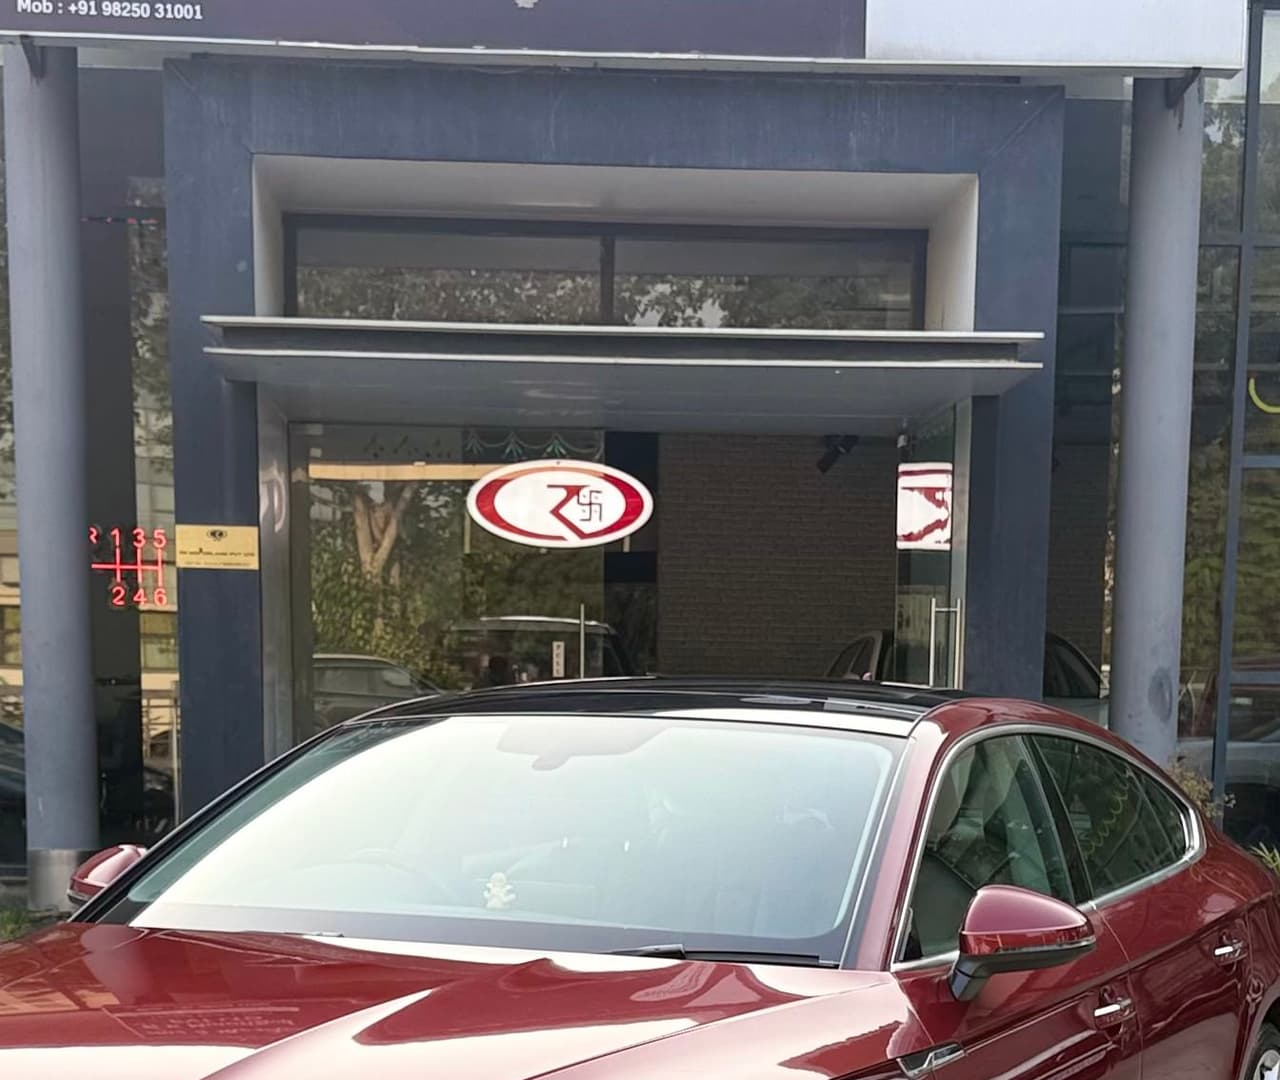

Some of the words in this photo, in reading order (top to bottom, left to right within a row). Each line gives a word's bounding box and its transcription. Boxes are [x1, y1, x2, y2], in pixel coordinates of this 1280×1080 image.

[17, 0, 53, 13] Mob
[68, 0, 98, 15] +91
[102, 1, 150, 18] 98250
[154, 4, 202, 20] 31001
[133, 528, 146, 548] 3
[154, 529, 167, 548] 5
[112, 586, 125, 606] 2
[133, 588, 147, 606] 4
[154, 588, 167, 606] 6
